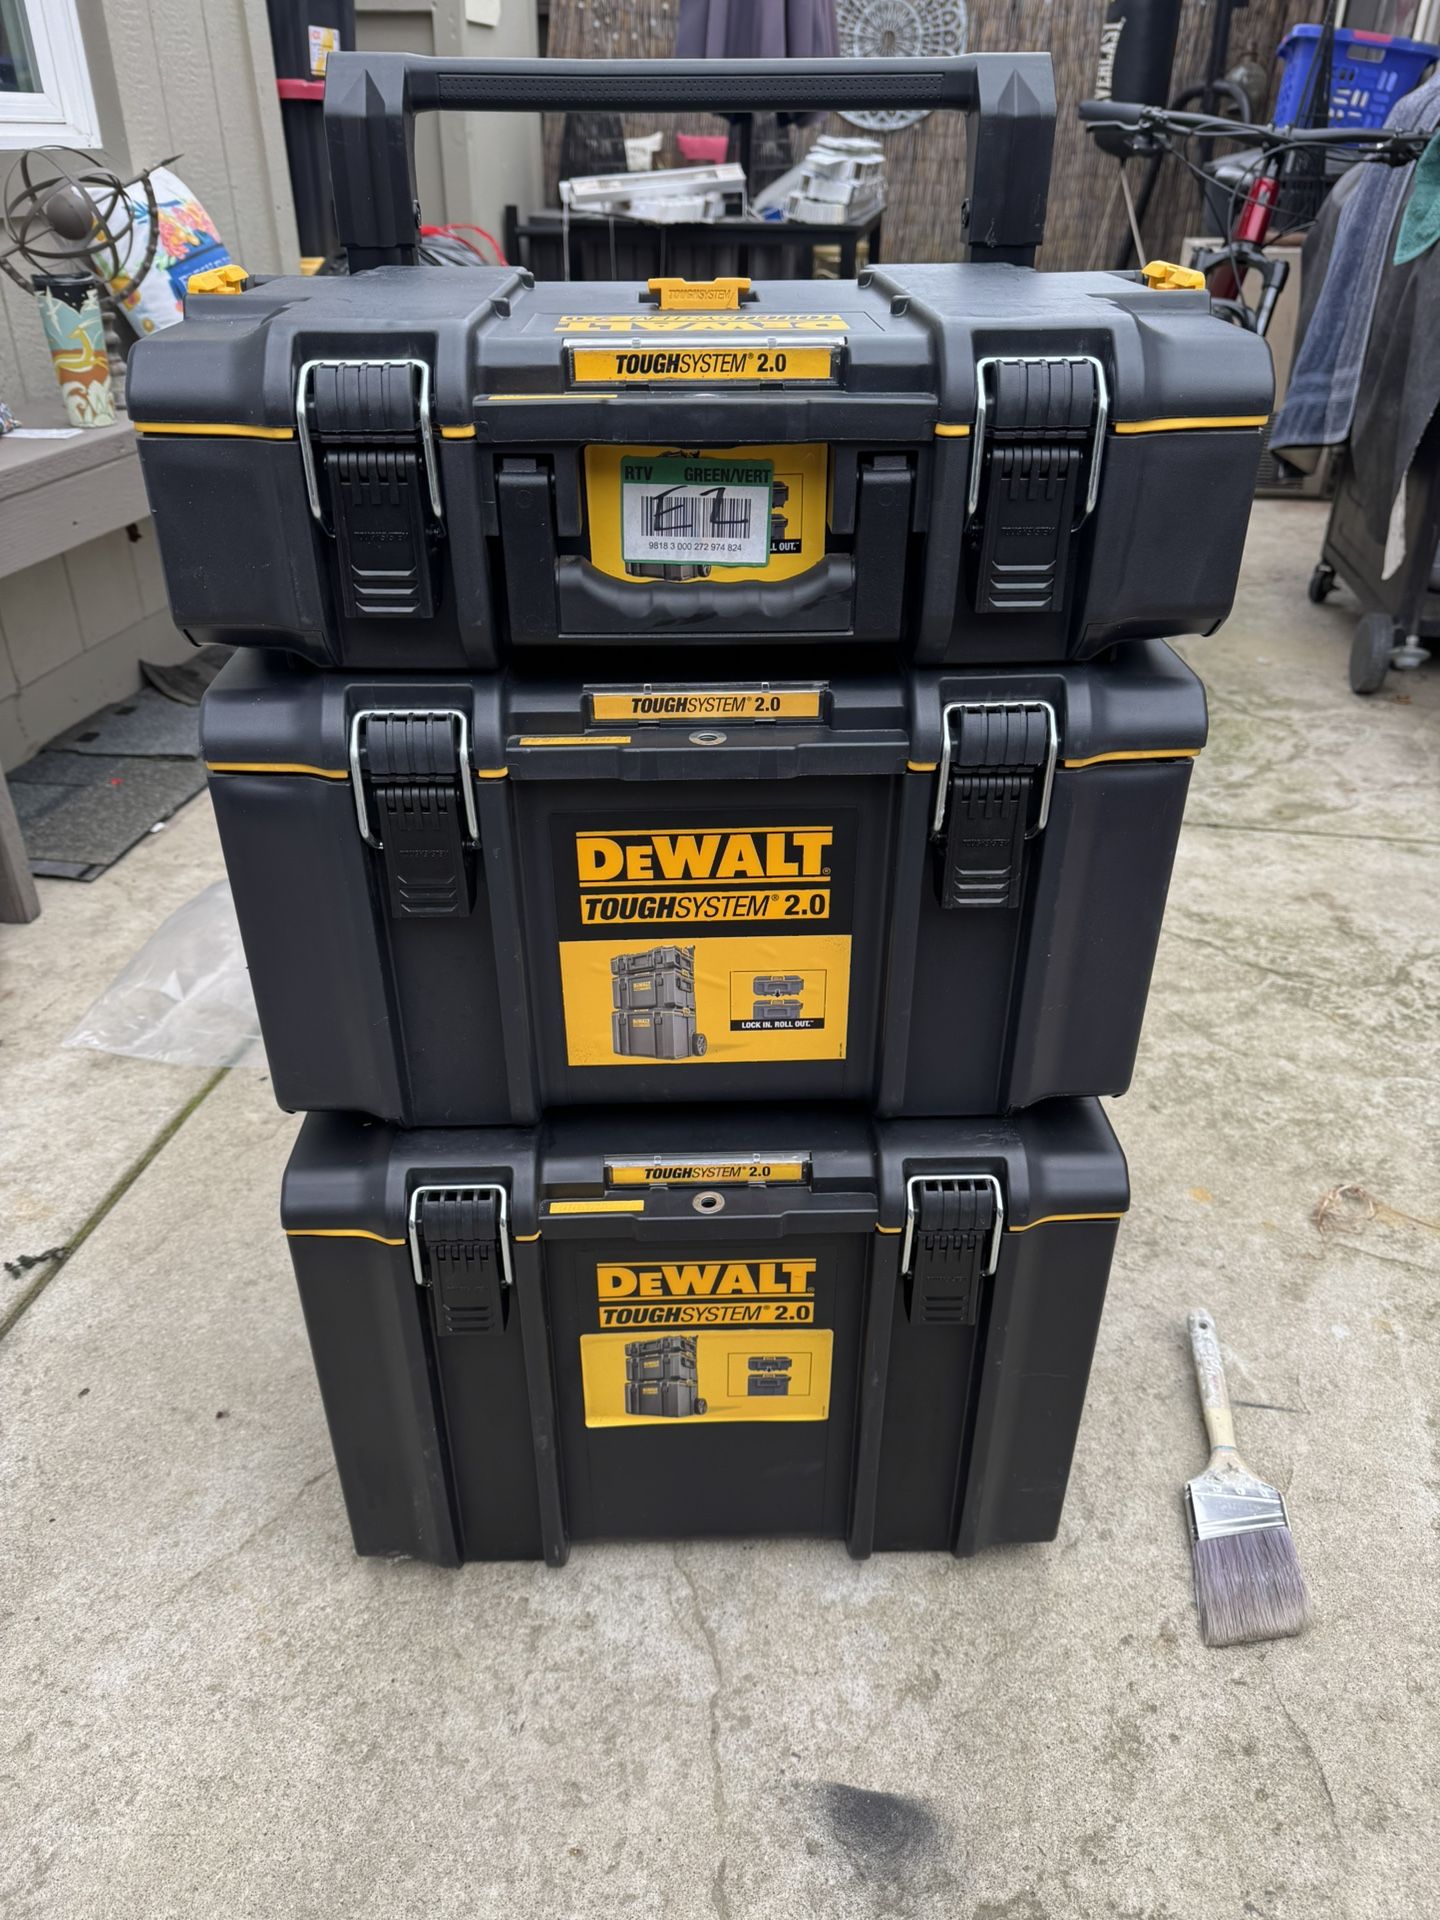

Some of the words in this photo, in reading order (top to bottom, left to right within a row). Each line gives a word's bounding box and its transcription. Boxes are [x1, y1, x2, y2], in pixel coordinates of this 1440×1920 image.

[757, 353, 787, 372] 2.0
[624, 466, 653, 480] RTV
[684, 467, 771, 484] GREEN/VERT
[648, 542, 669, 551] 9818
[670, 542, 676, 550] 3
[677, 542, 692, 551] 000
[694, 543, 709, 551] 272
[711, 543, 725, 552] 974
[727, 544, 742, 552] 824
[755, 697, 781, 712] 2.0
[784, 894, 825, 915] 2.0
[742, 1021, 761, 1029] LOCK
[762, 1021, 773, 1029] IN.
[774, 1020, 793, 1028] ROLL
[749, 1166, 771, 1177] 2.0
[775, 1305, 810, 1320] 2.0
